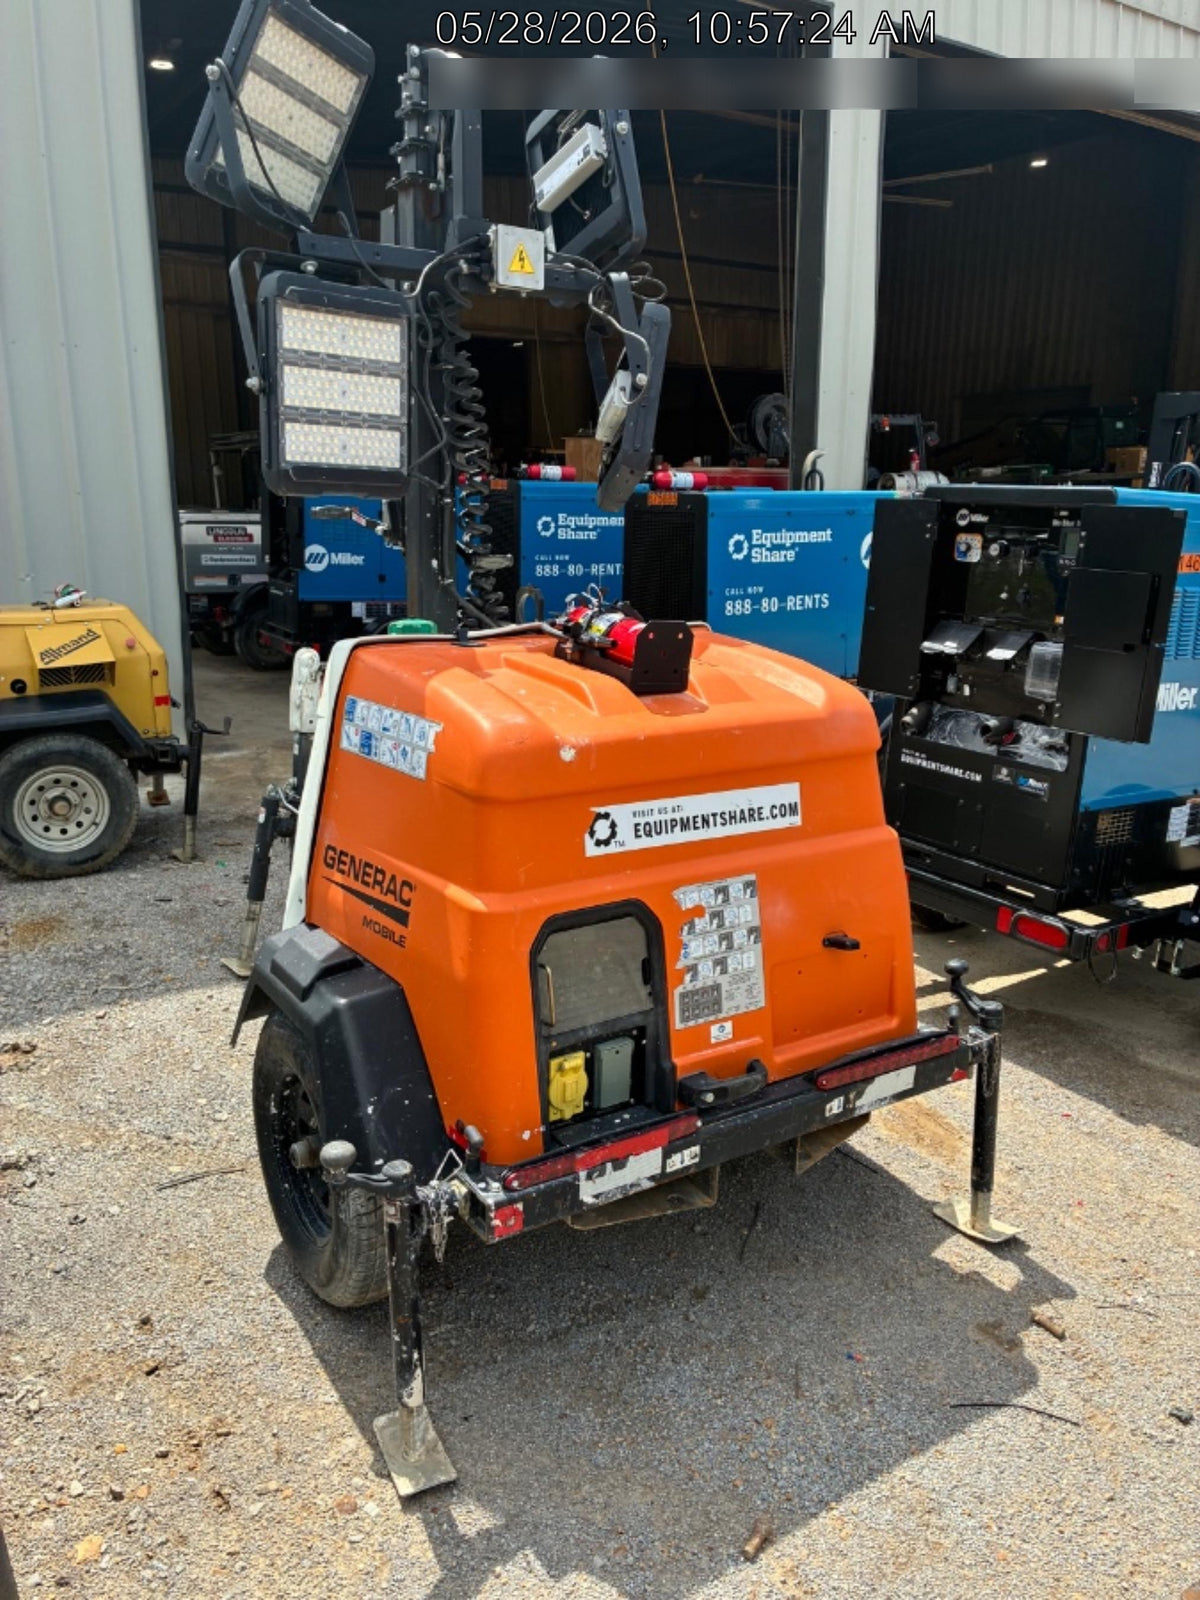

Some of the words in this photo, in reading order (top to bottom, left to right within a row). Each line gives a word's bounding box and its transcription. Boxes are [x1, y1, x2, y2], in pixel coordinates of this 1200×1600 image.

[557, 513, 625, 528] Equipmen
[557, 527, 598, 540] Share
[751, 528, 833, 548] Equipment
[330, 552, 365, 566] Miller
[751, 547, 796, 563] Share
[535, 563, 624, 577] 888-80-RENT
[725, 593, 830, 616] 888-80-RENTS
[40, 628, 101, 666] Allmand
[632, 808, 654, 818] VISIT
[657, 806, 669, 815] US
[634, 801, 799, 839] EQUIPMENTSHARE.COM
[323, 844, 414, 908] GENERAC
[362, 915, 407, 949] MOBILE
